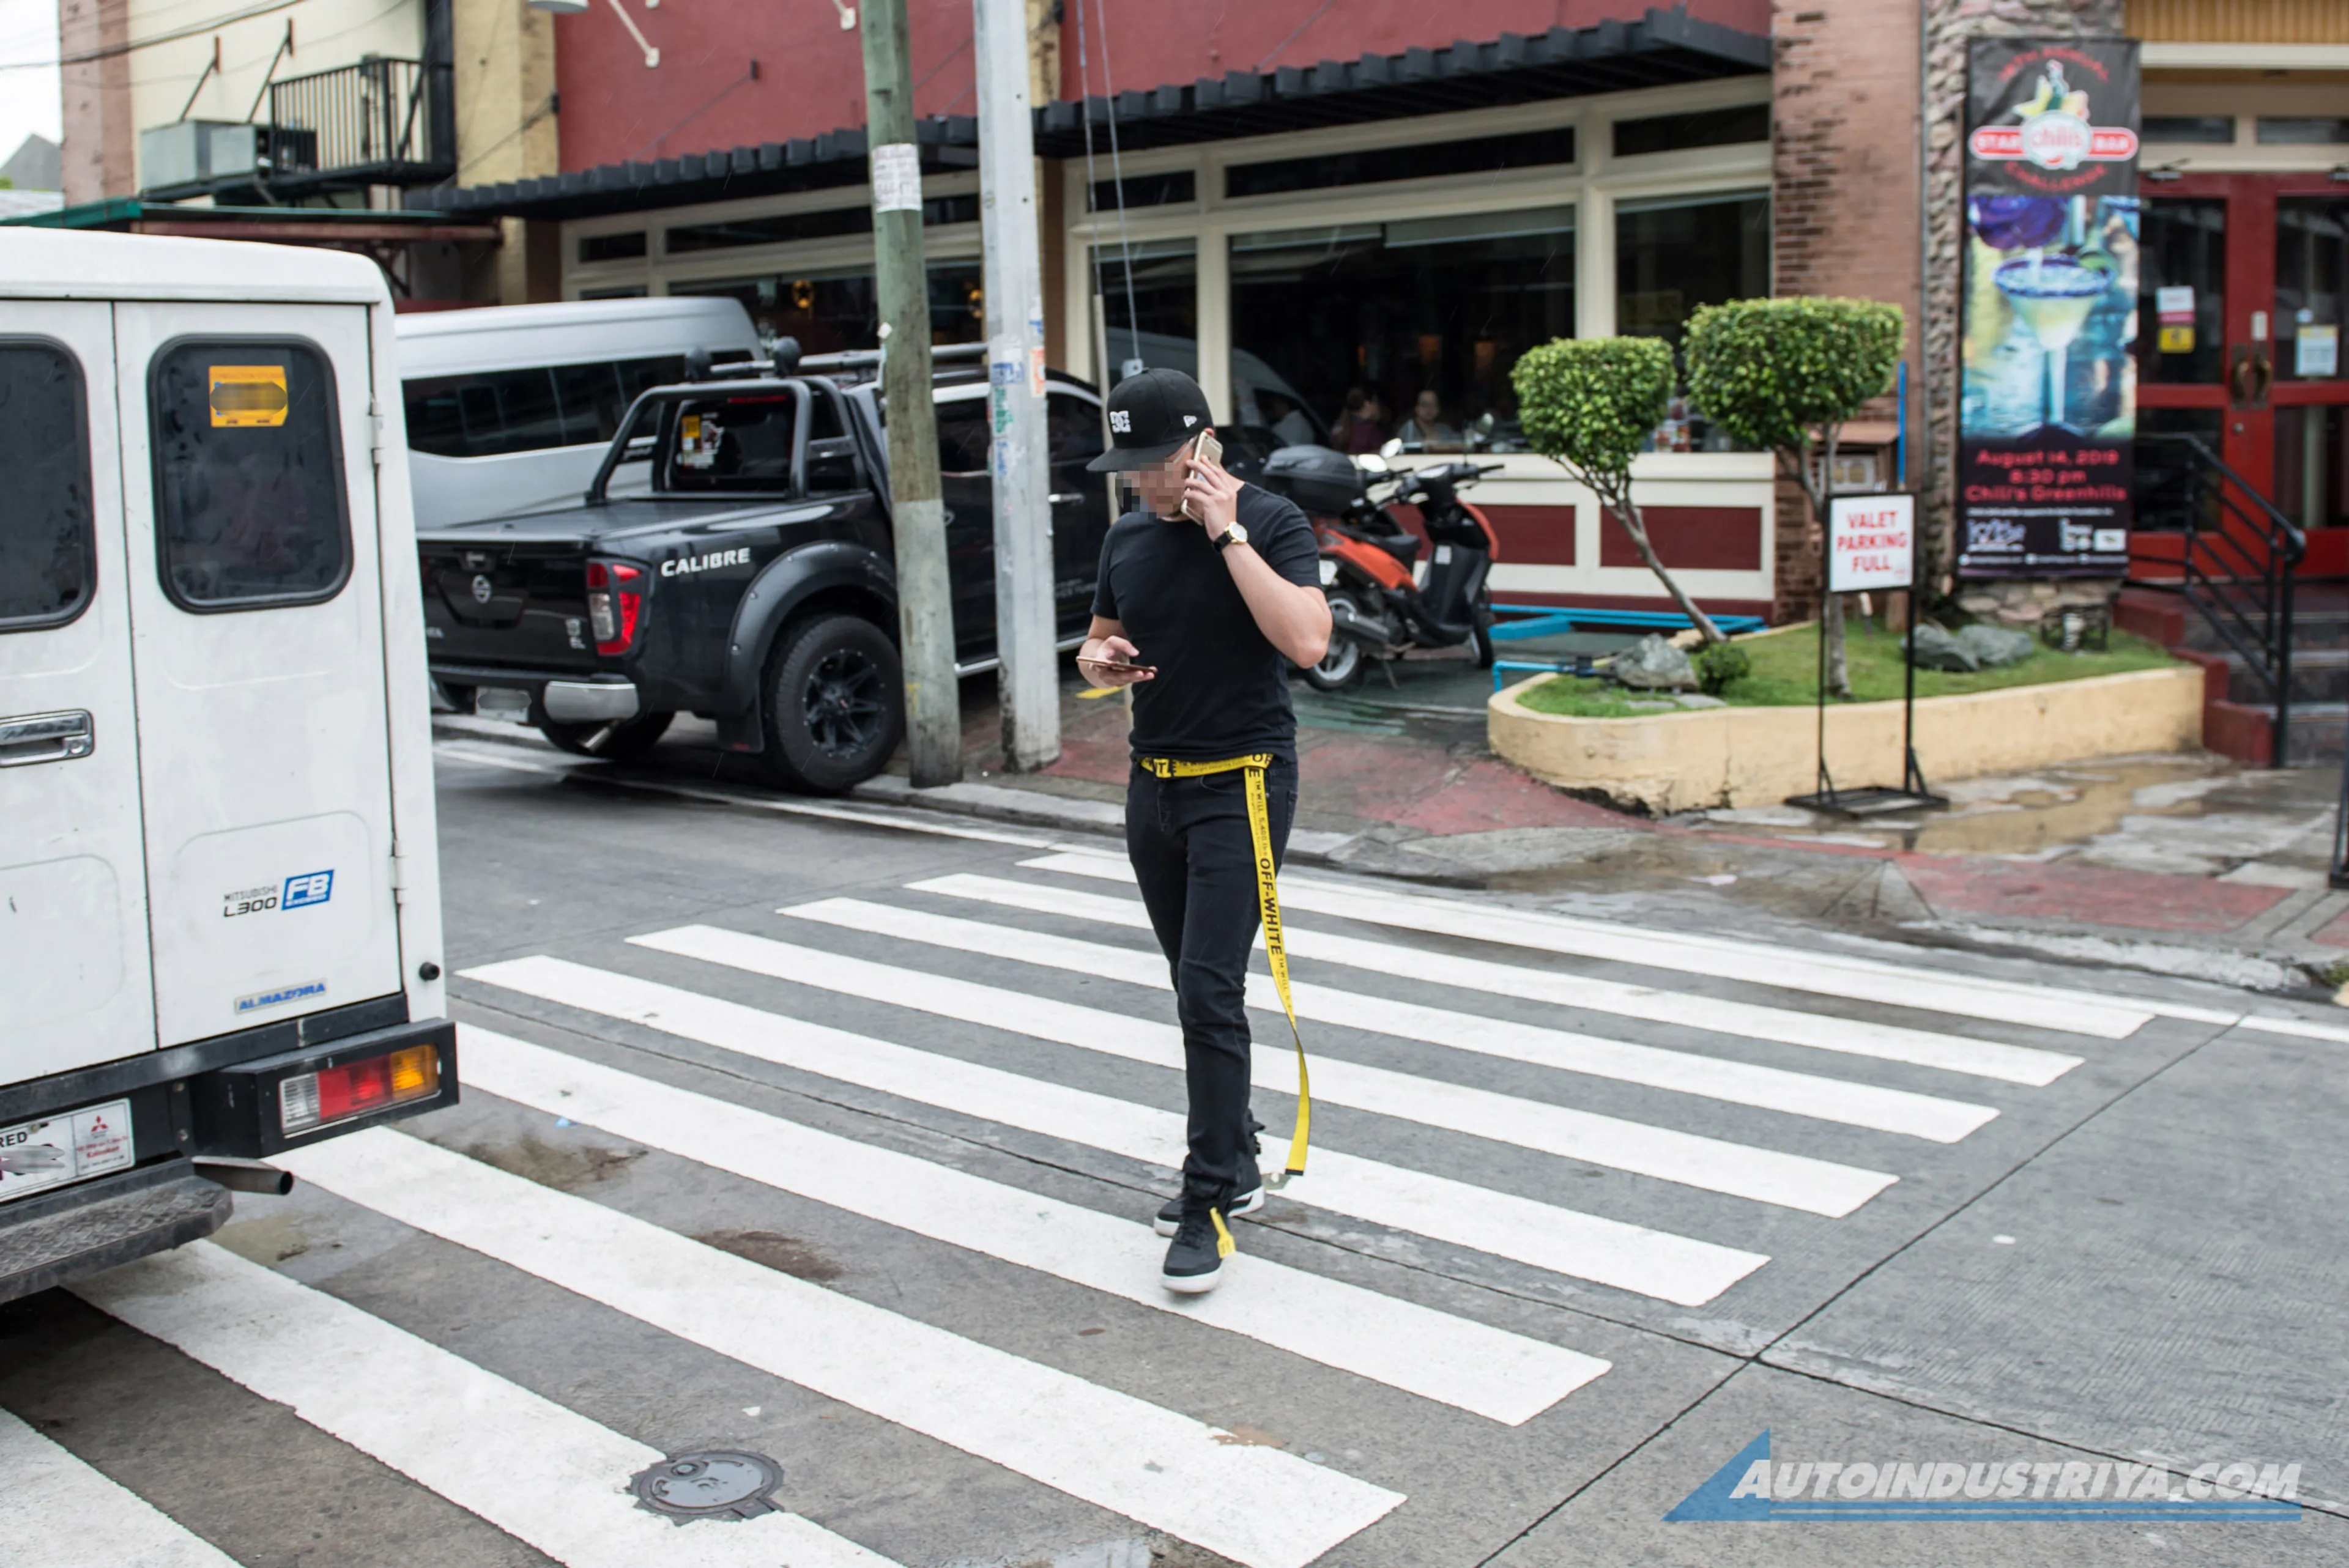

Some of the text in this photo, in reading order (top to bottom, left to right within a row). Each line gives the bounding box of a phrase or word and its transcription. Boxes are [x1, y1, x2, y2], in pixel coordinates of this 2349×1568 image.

[2095, 138, 2130, 152] BAR
[1976, 449, 2044, 469] August
[2057, 470, 2087, 486] pm
[1965, 484, 2128, 502] Chili's Greenhills
[1847, 510, 1898, 529] VALET
[1837, 530, 1907, 552] PARKING
[661, 547, 751, 578] CALIBRE
[1853, 554, 1891, 572] FULL
[223, 873, 330, 918] L300 FB
[1260, 857, 1283, 955] OFF-WHITE
[239, 982, 326, 1011] ALMAZORA
